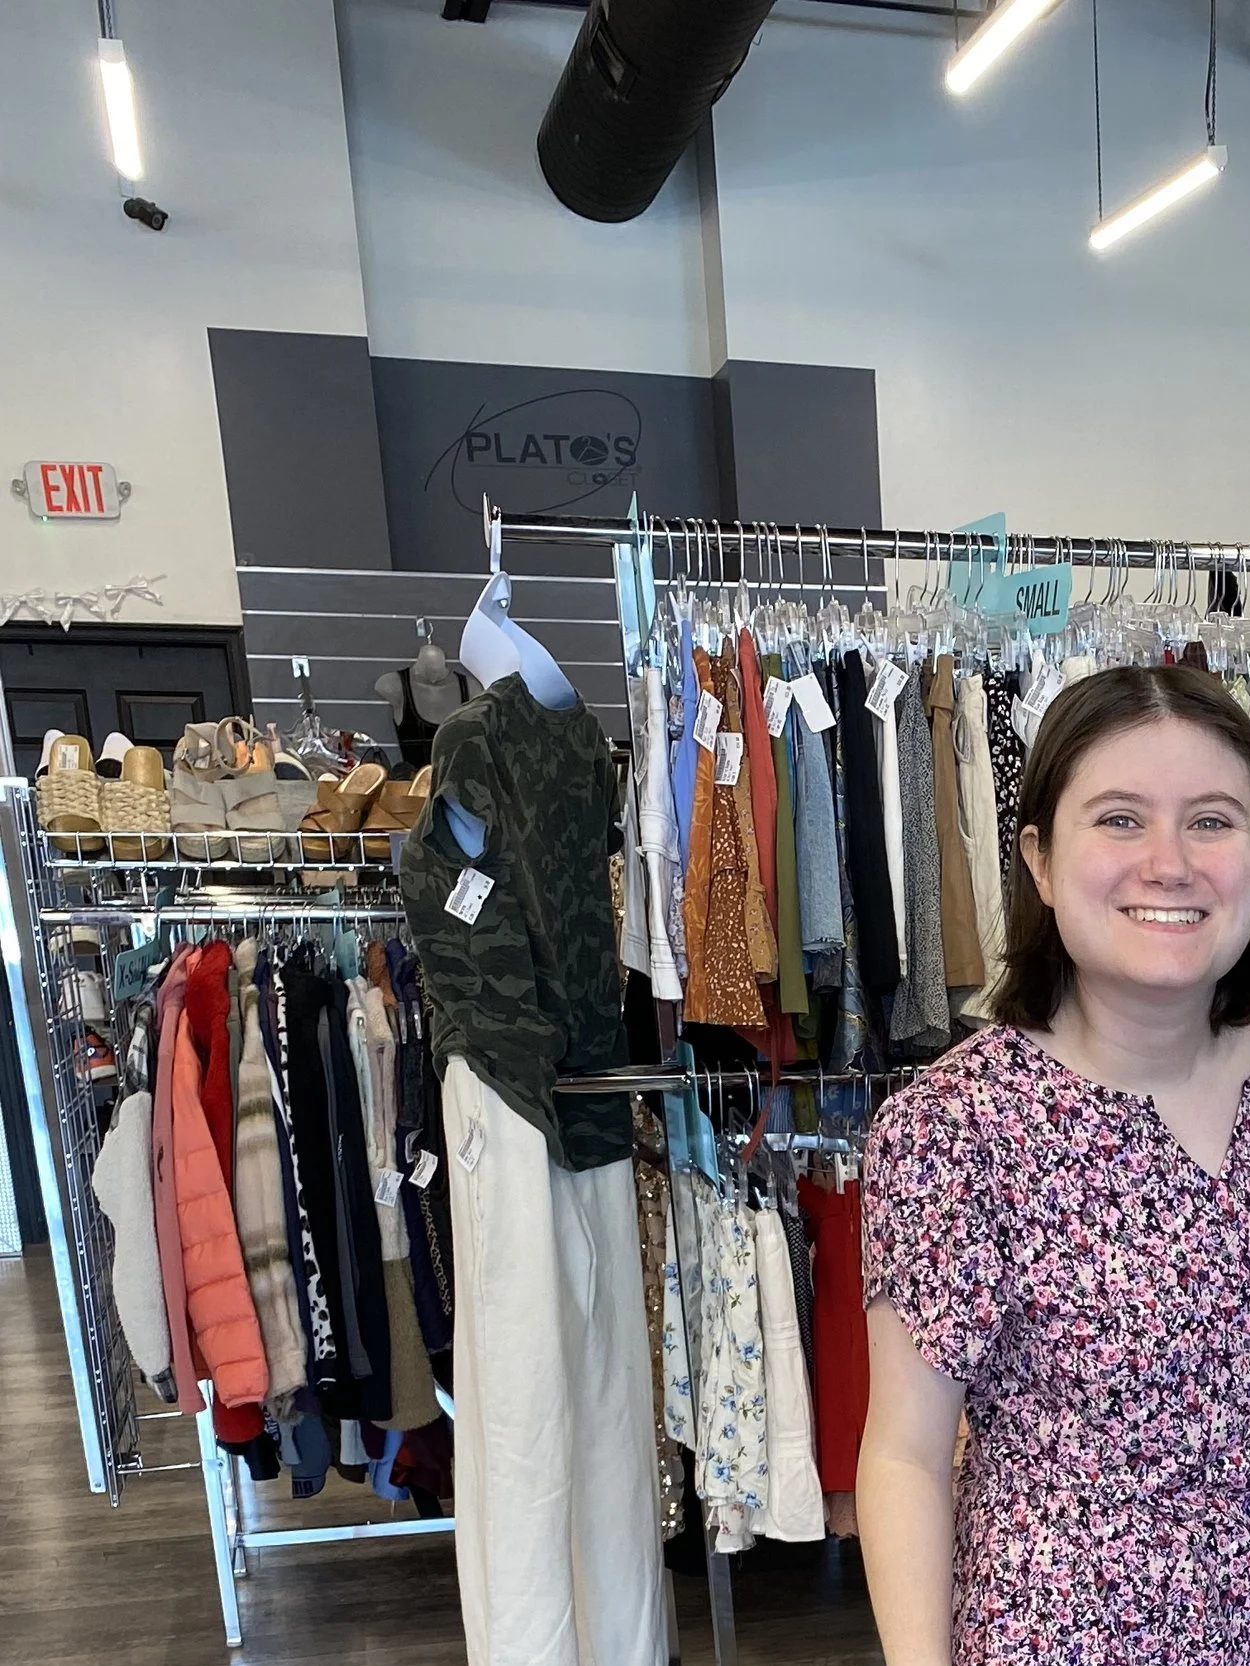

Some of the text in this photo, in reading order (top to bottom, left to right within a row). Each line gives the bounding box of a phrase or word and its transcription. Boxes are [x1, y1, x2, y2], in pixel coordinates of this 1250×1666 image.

[465, 431, 637, 467] PLATO'S
[40, 464, 105, 514] EXIT
[1015, 579, 1061, 621] SMALL
